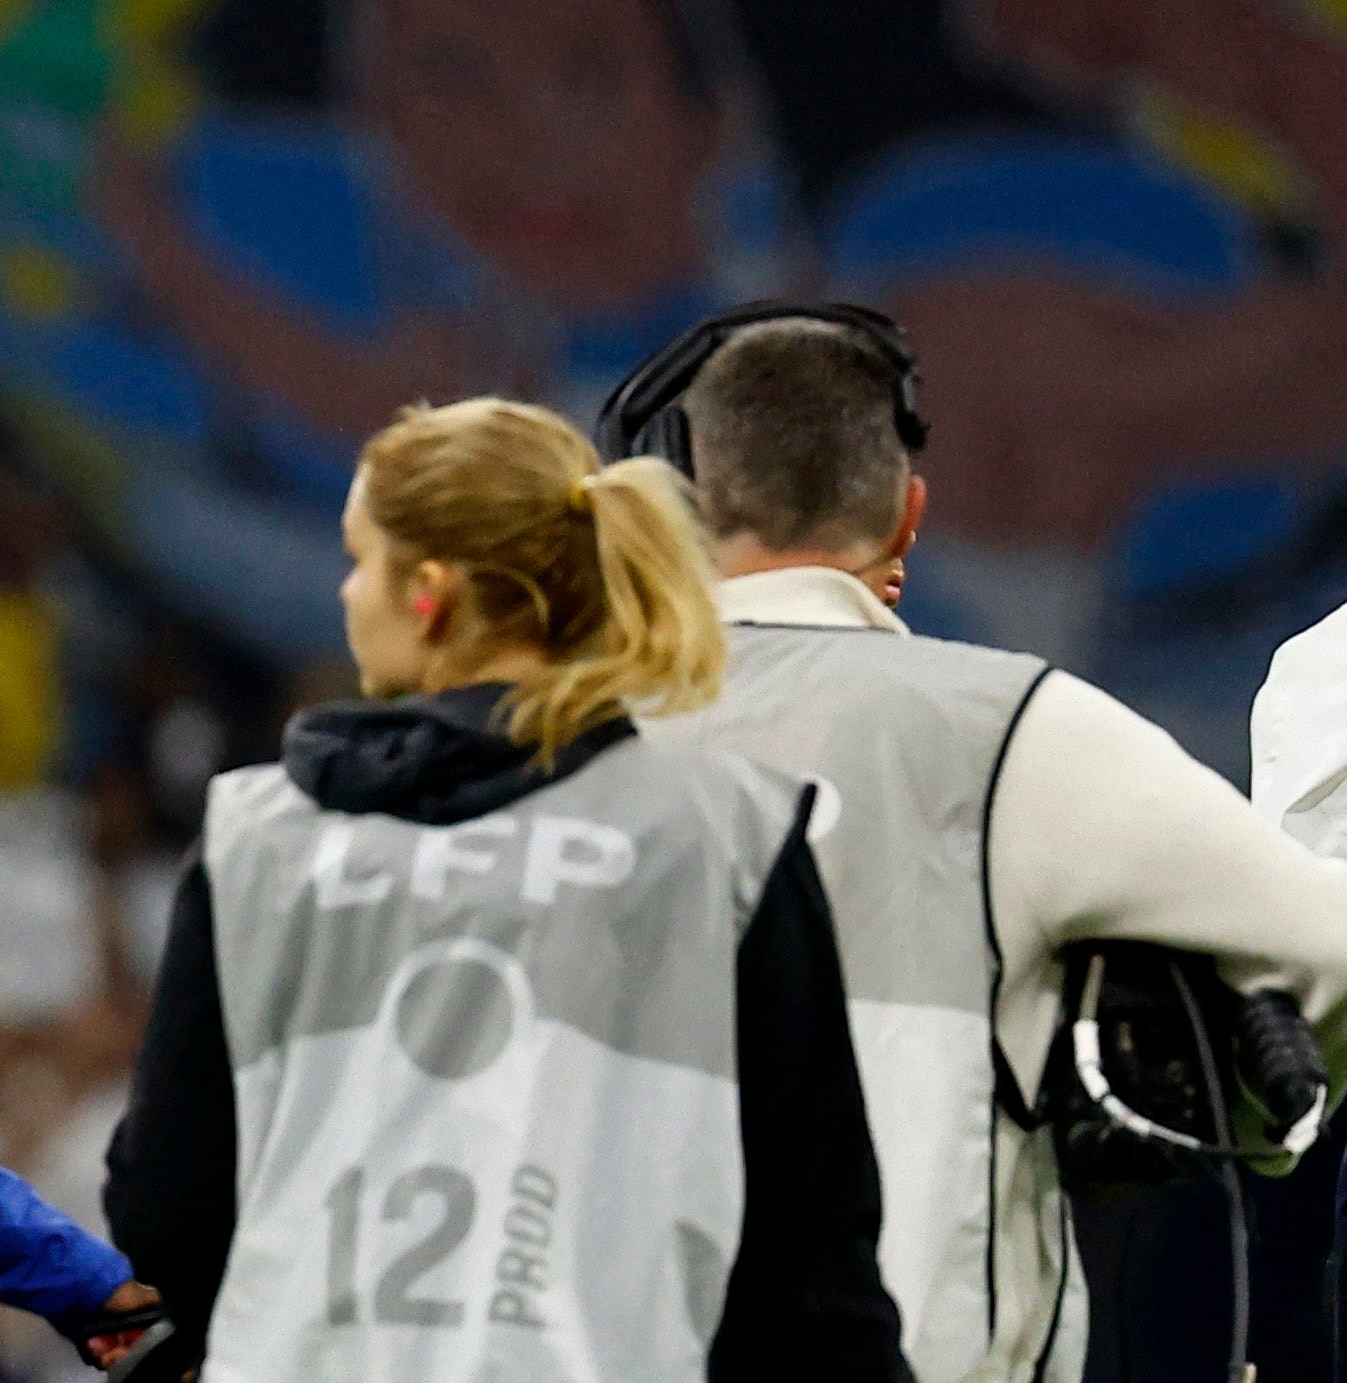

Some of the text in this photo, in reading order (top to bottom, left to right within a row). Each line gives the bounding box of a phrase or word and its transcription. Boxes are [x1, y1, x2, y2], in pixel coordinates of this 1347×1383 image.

[313, 814, 636, 908] LFP
[325, 1164, 476, 1328] 12
[488, 1164, 557, 1330] PROD
